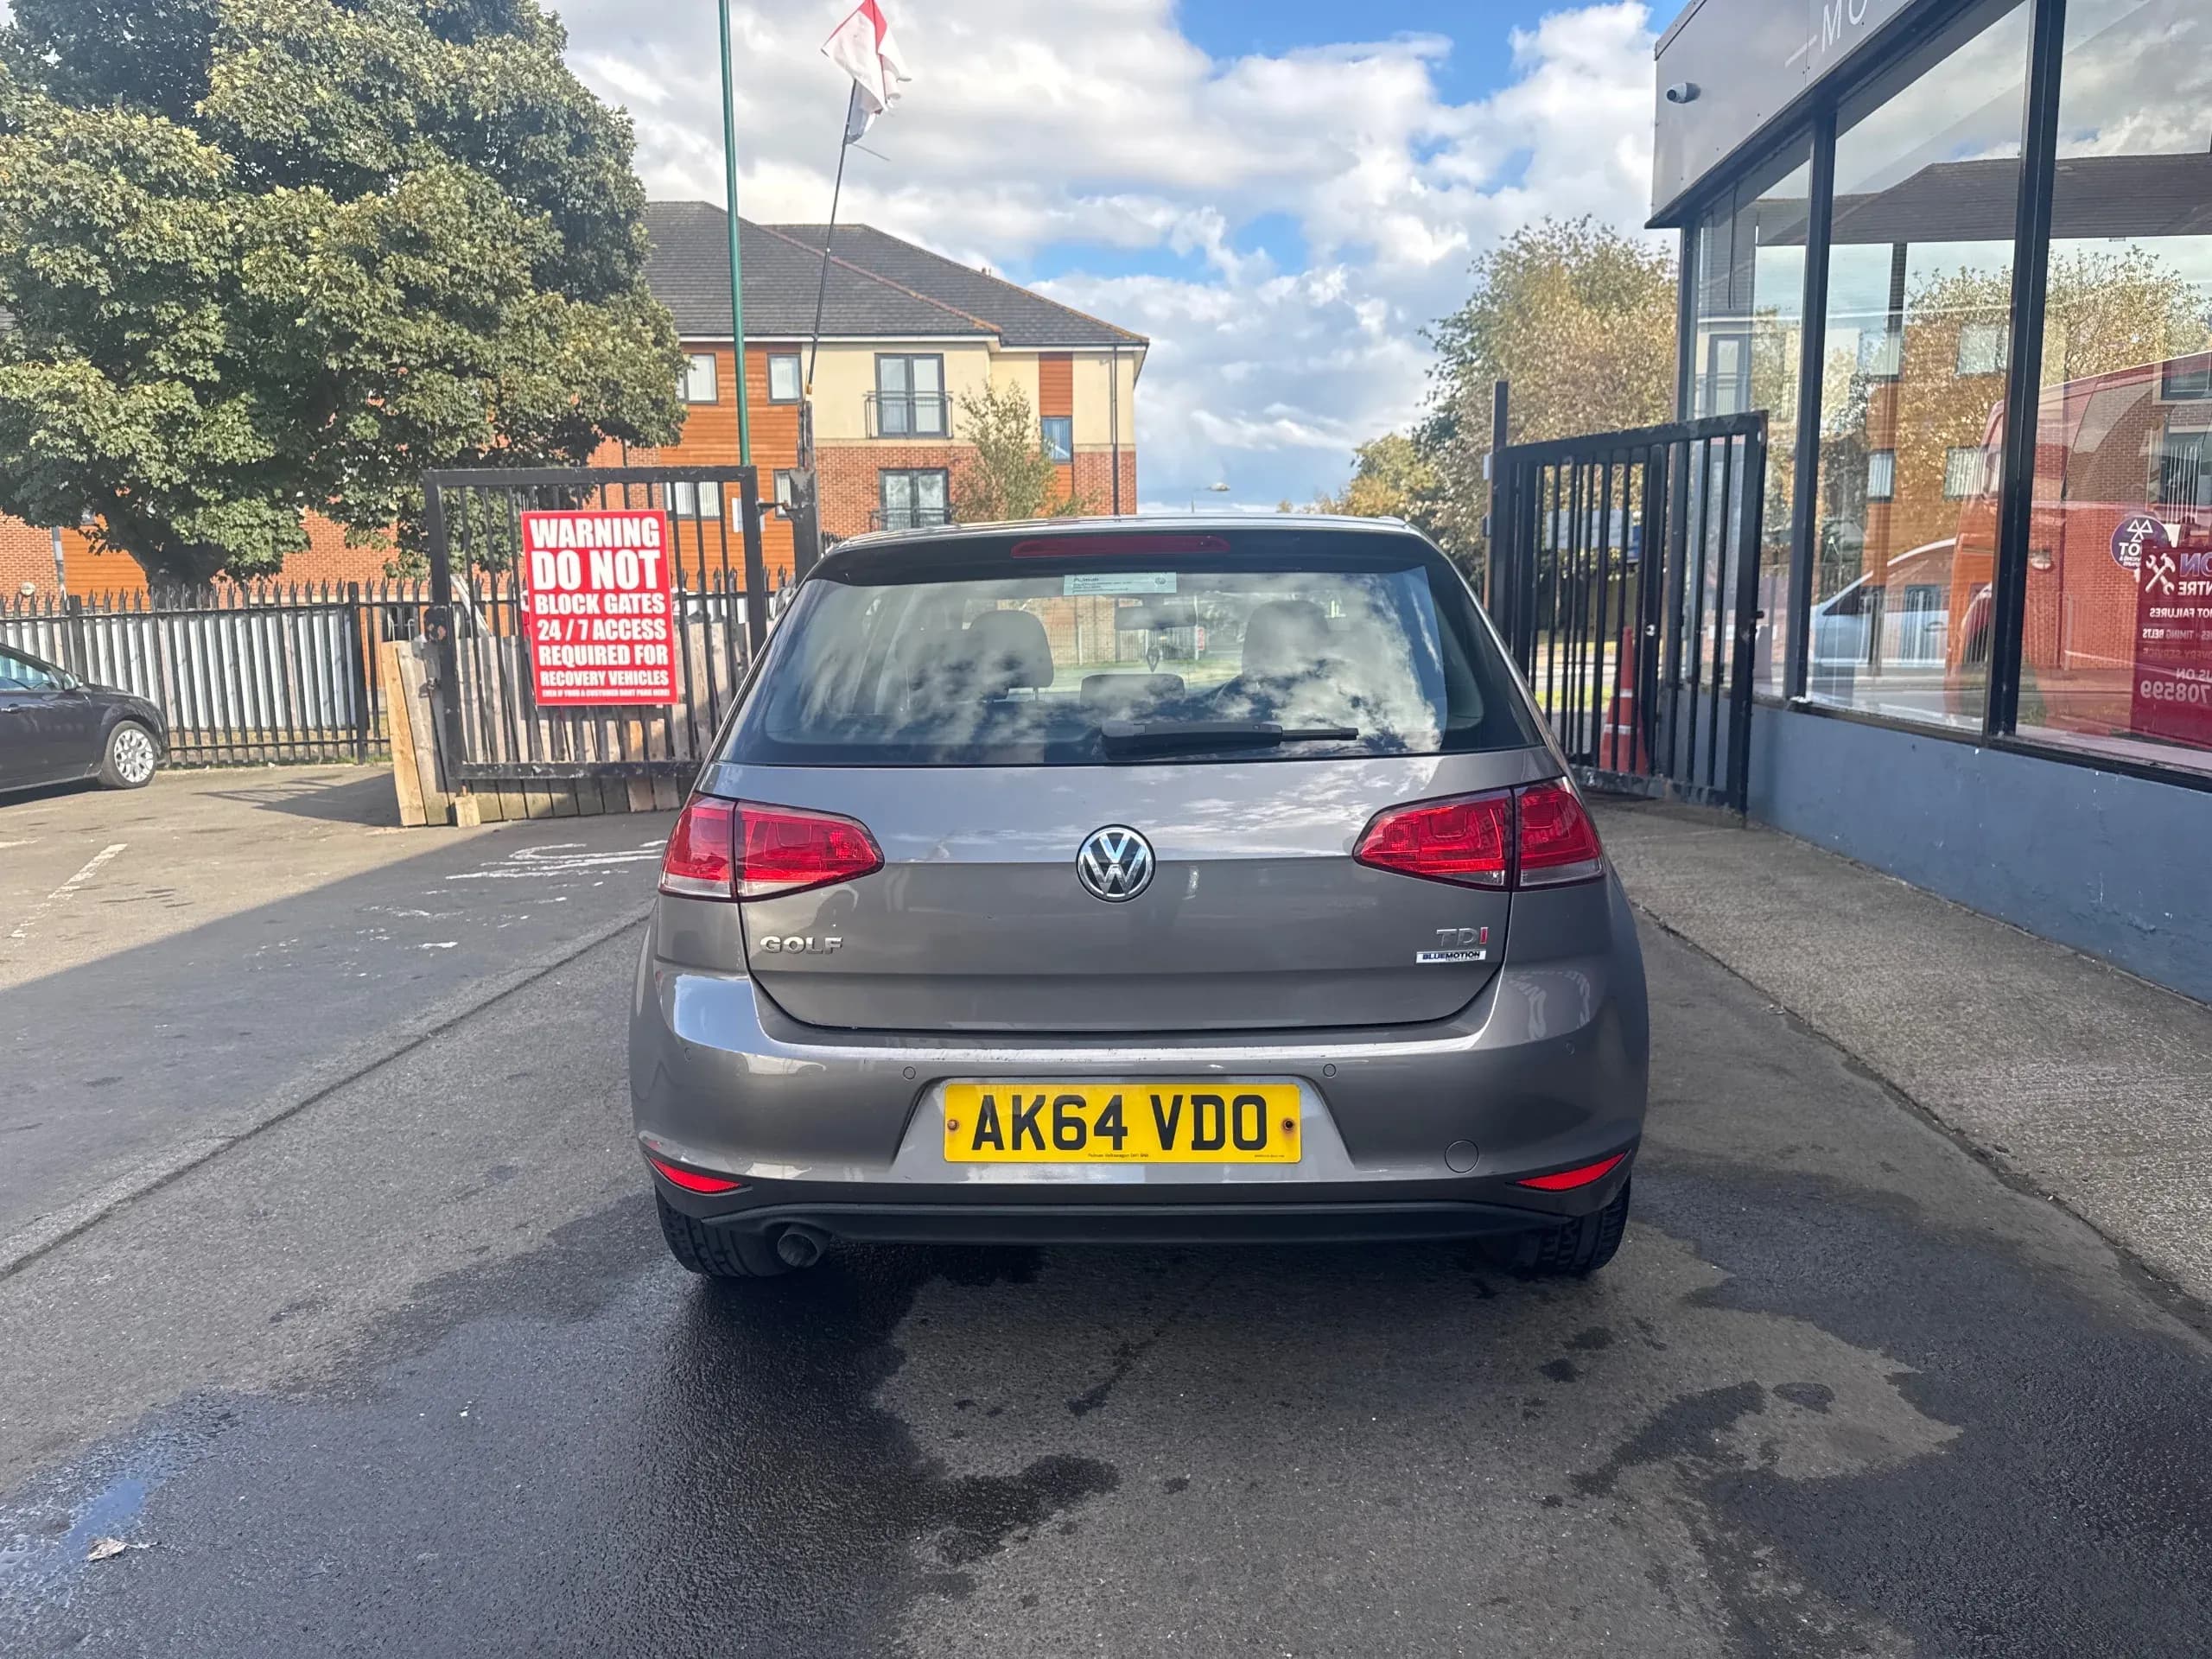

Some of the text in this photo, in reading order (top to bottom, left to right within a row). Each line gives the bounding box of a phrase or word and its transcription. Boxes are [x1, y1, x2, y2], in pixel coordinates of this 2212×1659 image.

[529, 518, 660, 549] WARNING
[531, 550, 661, 591] DO NOT
[534, 593, 666, 615] BLOCK GATES
[592, 619, 667, 641] ACCESS
[538, 645, 669, 668] REQUIRED FOR
[540, 670, 670, 687] RECOVERY VEHICLES
[760, 936, 843, 954] GOLF
[1436, 927, 1489, 947] TDI
[1422, 950, 1480, 960] BLUEMOTION
[971, 1094, 1268, 1151] AK64 VDO
